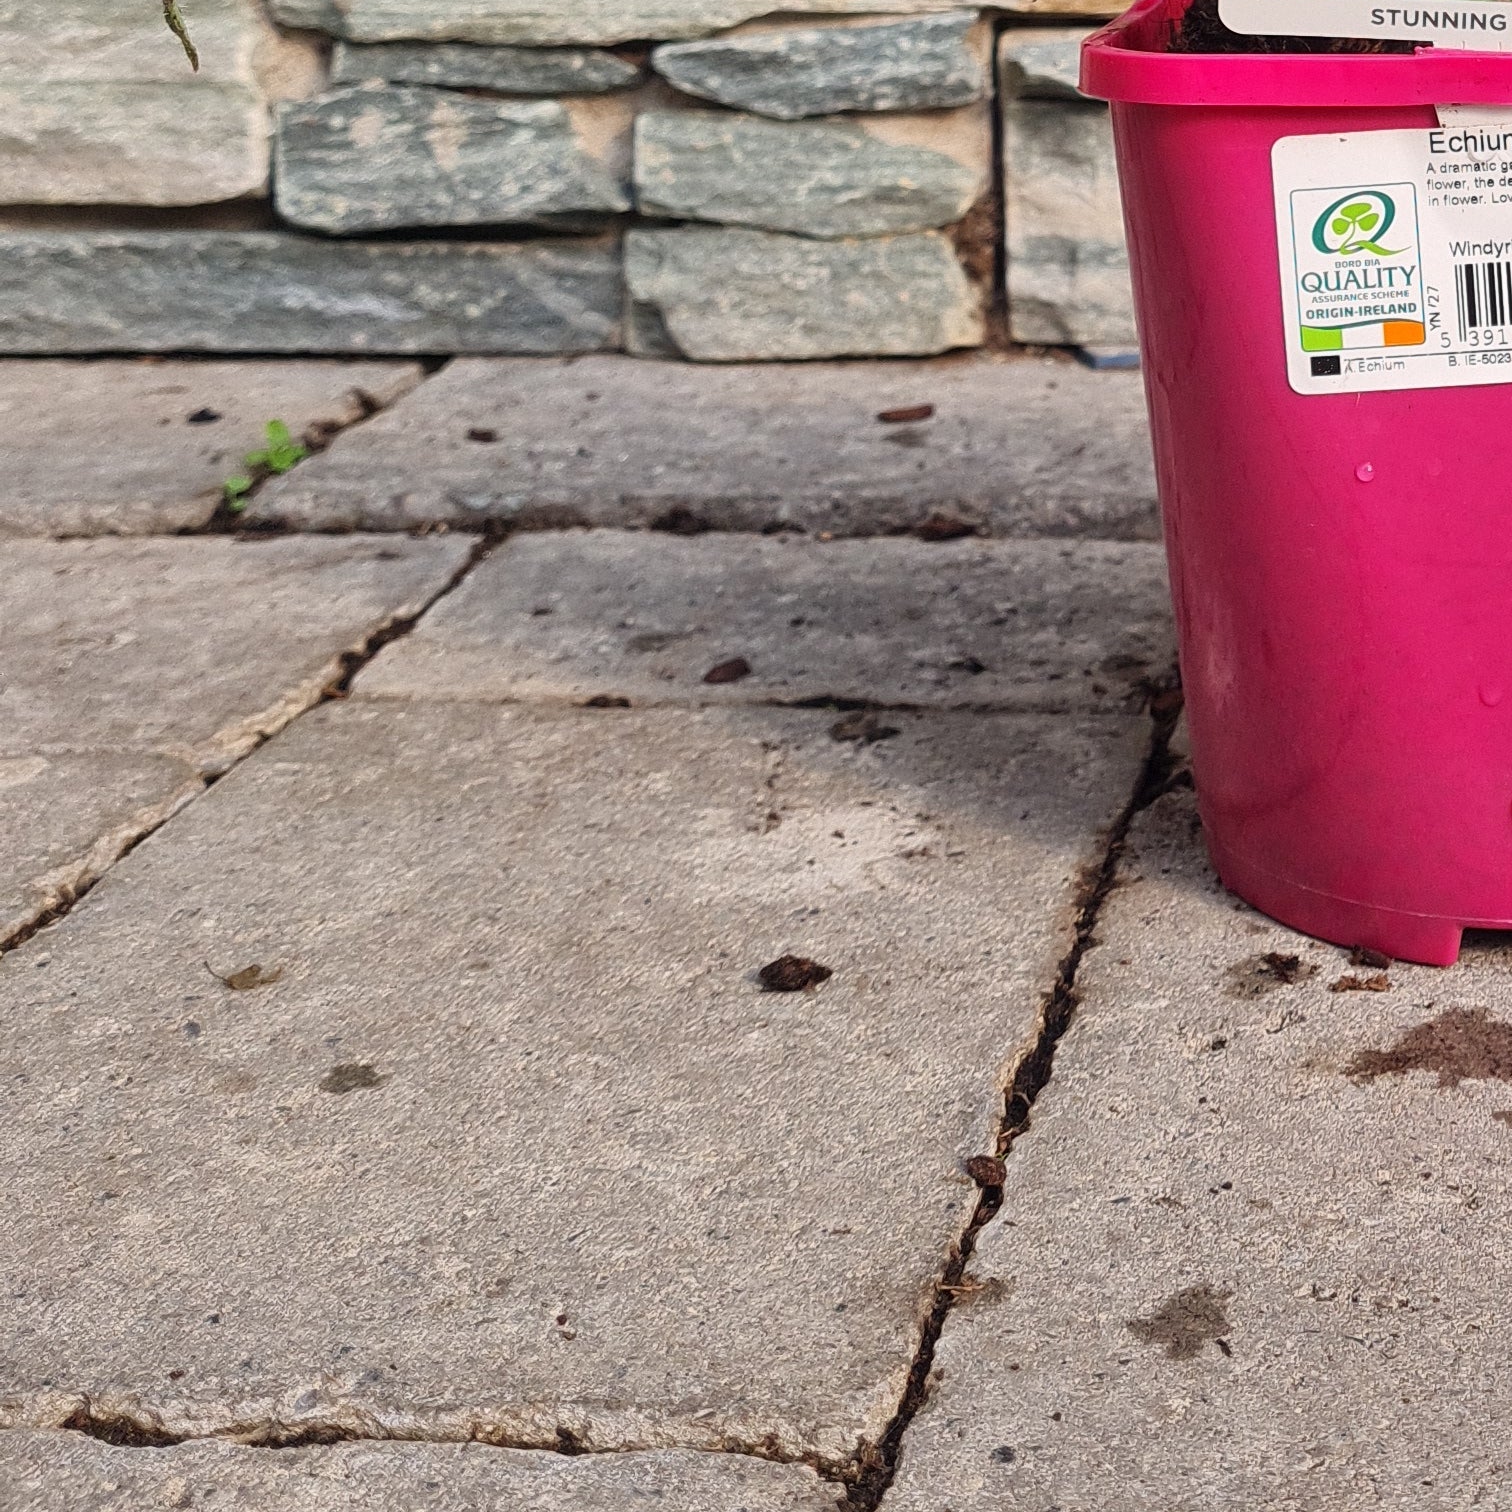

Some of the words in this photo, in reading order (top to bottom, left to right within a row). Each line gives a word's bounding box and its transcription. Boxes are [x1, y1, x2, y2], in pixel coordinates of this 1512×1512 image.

[1370, 8, 1507, 31] STUNNING
[1426, 162, 1436, 174] A
[1440, 161, 1497, 174] dramatic
[1427, 179, 1470, 192] flower,
[1474, 176, 1495, 188] the
[1428, 195, 1439, 206] in
[1443, 194, 1487, 205] flower.
[1335, 259, 1361, 268] BORD
[1364, 258, 1381, 267] BIA
[1301, 265, 1416, 294] QUALITY
[1312, 293, 1368, 304] ASSURANCE
[1371, 290, 1409, 300] SCHEME
[1306, 303, 1417, 320] ORIGIN-IRELAND
[1440, 332, 1451, 348] 5
[1359, 359, 1405, 373] Echium
